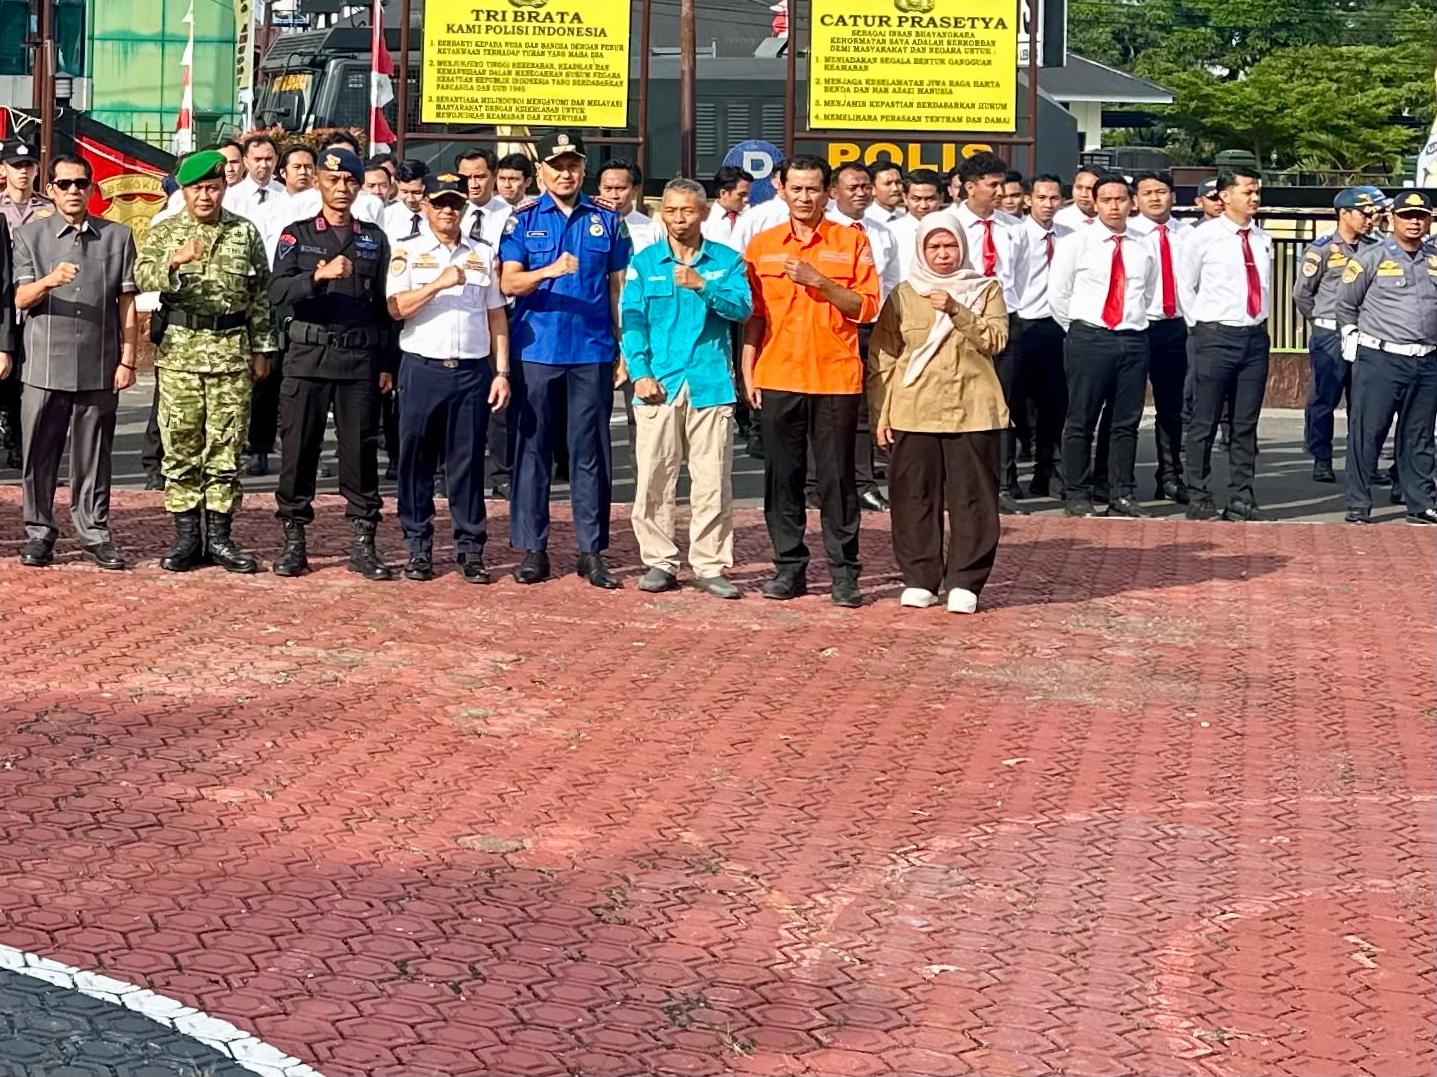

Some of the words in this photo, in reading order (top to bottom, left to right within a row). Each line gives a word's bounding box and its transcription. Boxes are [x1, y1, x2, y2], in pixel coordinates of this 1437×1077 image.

[471, 9, 507, 22] TRI
[512, 10, 583, 24] BRATA
[820, 13, 892, 28] CATUR
[897, 14, 1008, 30] PRASETYA
[446, 23, 481, 34] KAMI
[485, 24, 528, 35] POLISI
[532, 25, 606, 37] INDONESIA
